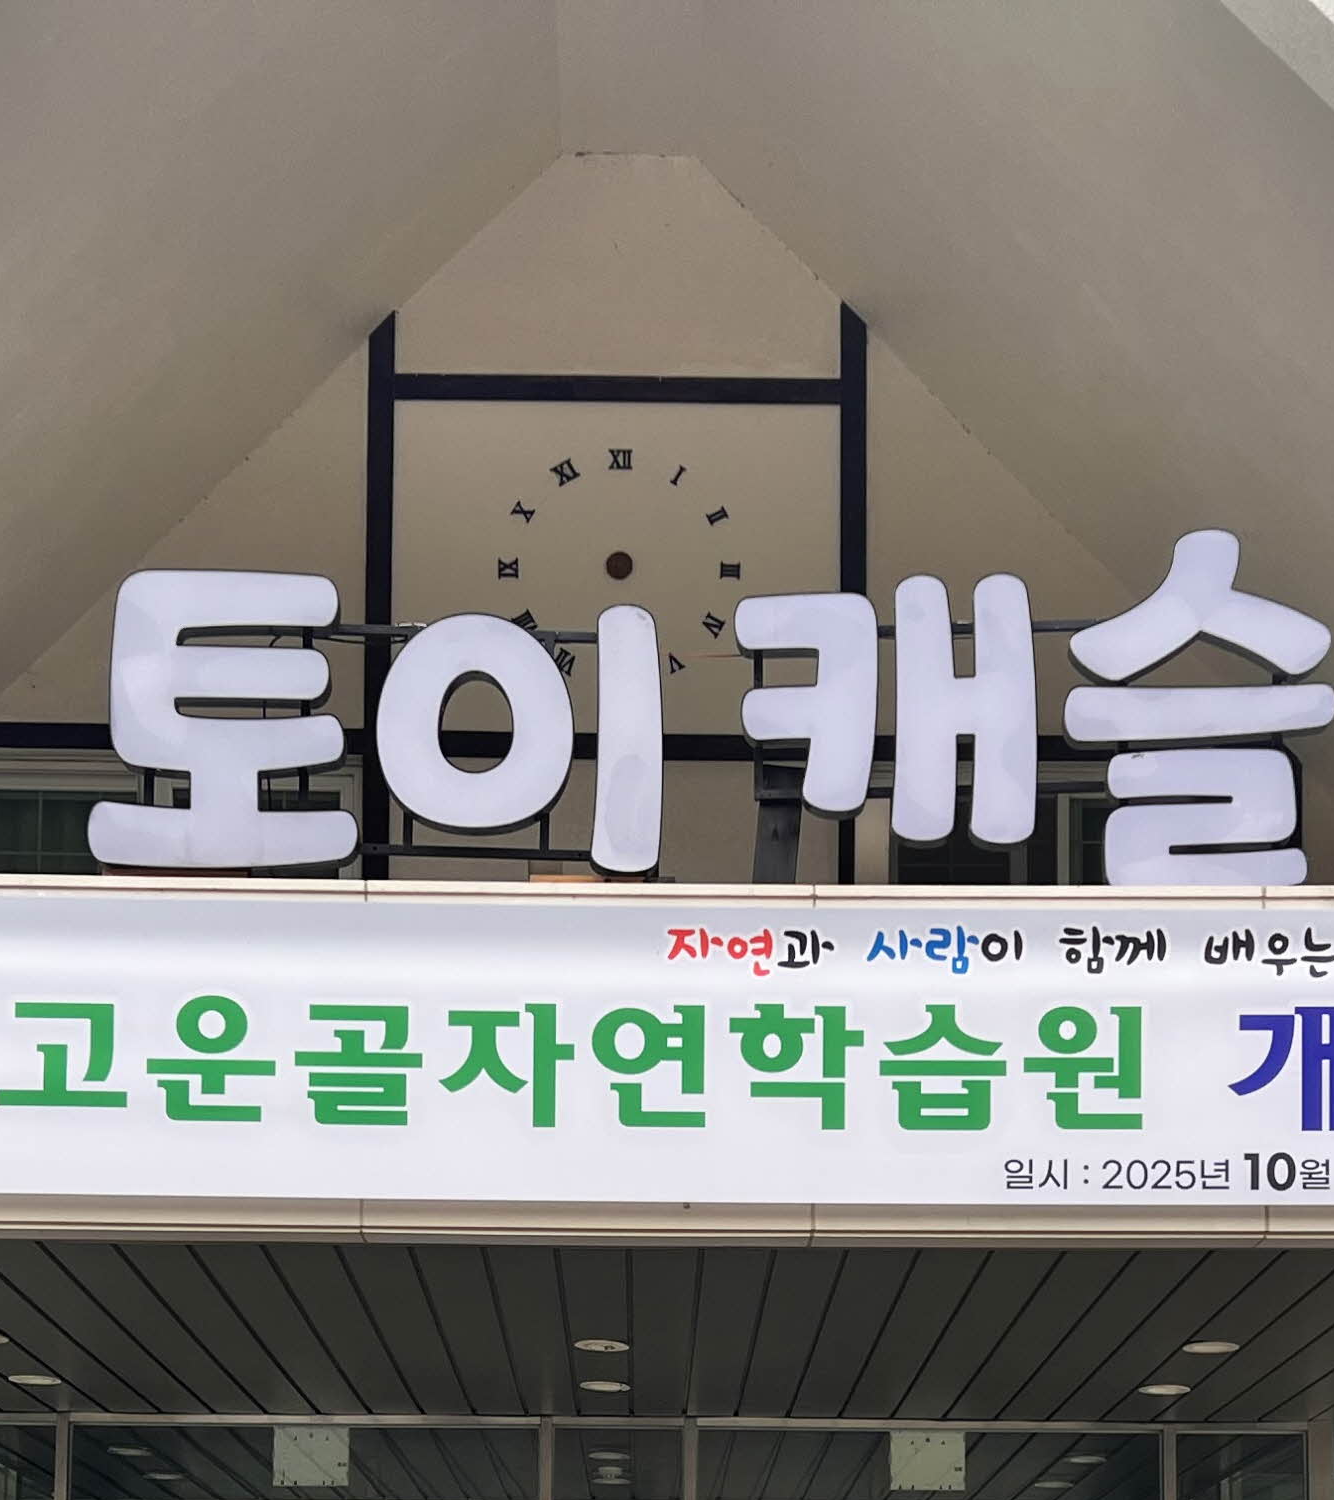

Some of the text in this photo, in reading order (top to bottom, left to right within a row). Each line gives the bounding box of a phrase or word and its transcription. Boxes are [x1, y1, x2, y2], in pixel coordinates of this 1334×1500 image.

[668, 928, 834, 976] 자연과
[867, 926, 1022, 974] 사람이
[1059, 926, 1166, 974] 함께
[1005, 1159, 1067, 1189] 일시
[1103, 1160, 1229, 1189] 2025년
[1244, 1153, 1330, 1191] 10월
